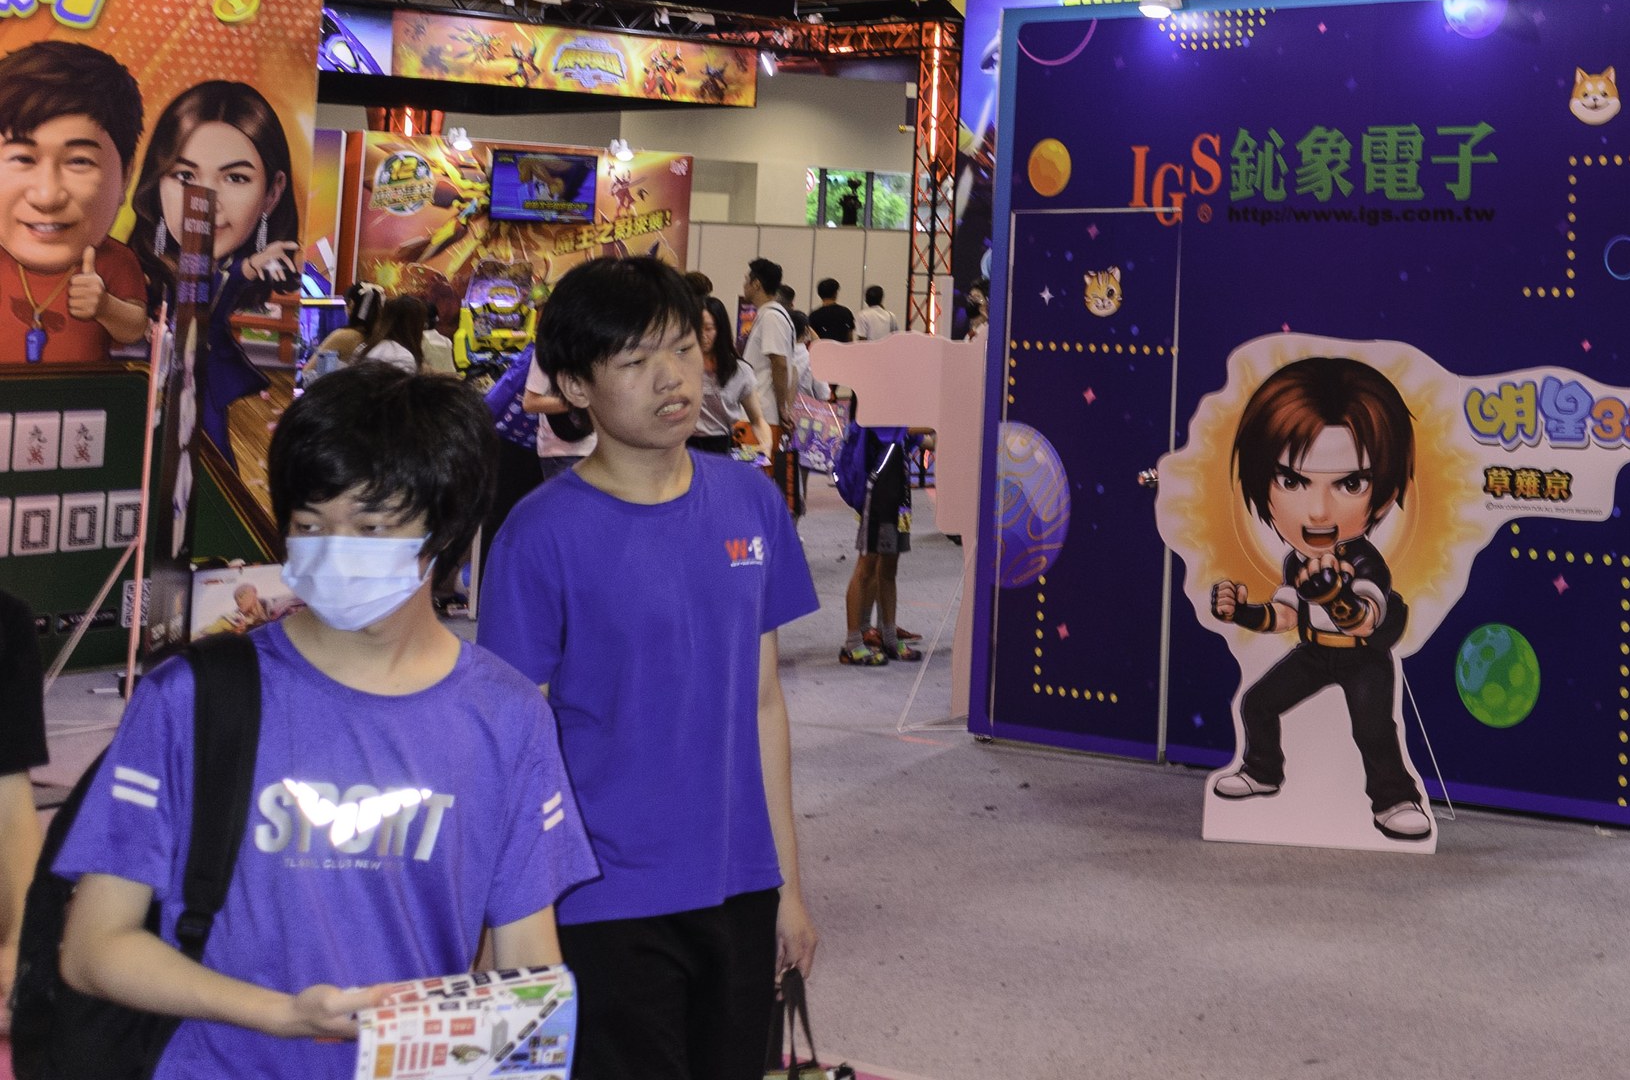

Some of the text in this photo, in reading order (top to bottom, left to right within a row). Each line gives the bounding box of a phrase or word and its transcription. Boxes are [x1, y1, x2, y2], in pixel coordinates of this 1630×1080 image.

[1128, 133, 1222, 227] IGS
[1228, 121, 1500, 203] 鈊象電子
